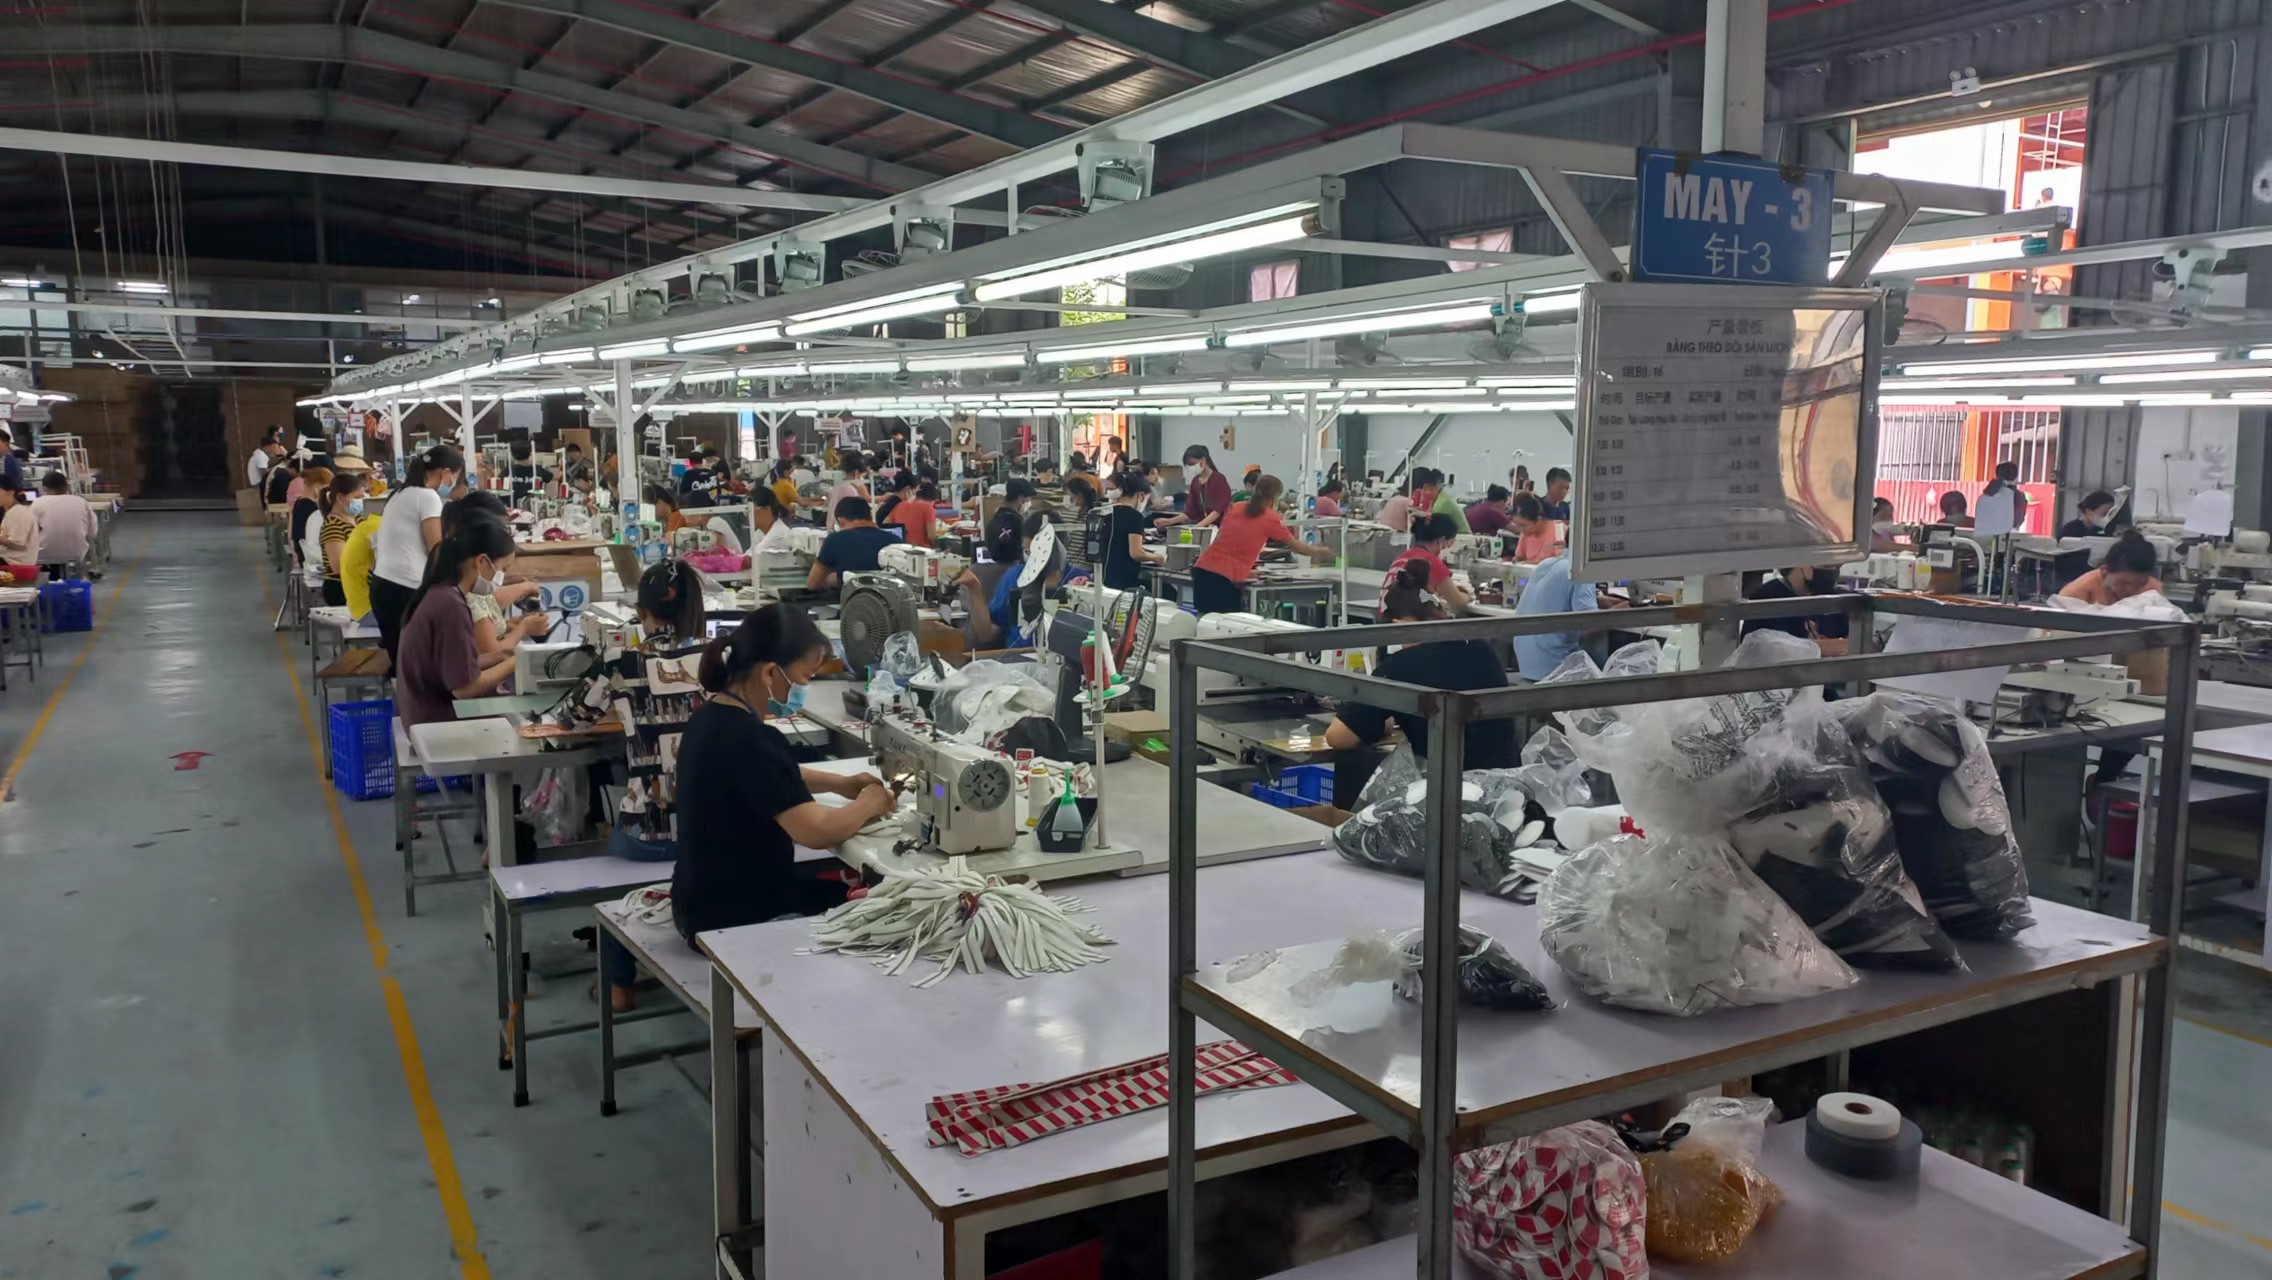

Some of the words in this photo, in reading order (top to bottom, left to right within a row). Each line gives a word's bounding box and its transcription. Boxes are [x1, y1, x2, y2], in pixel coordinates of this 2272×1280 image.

[1664, 172, 1753, 225] MAY
[1790, 187, 1813, 232] 3
[1698, 341, 1722, 353] THEO
